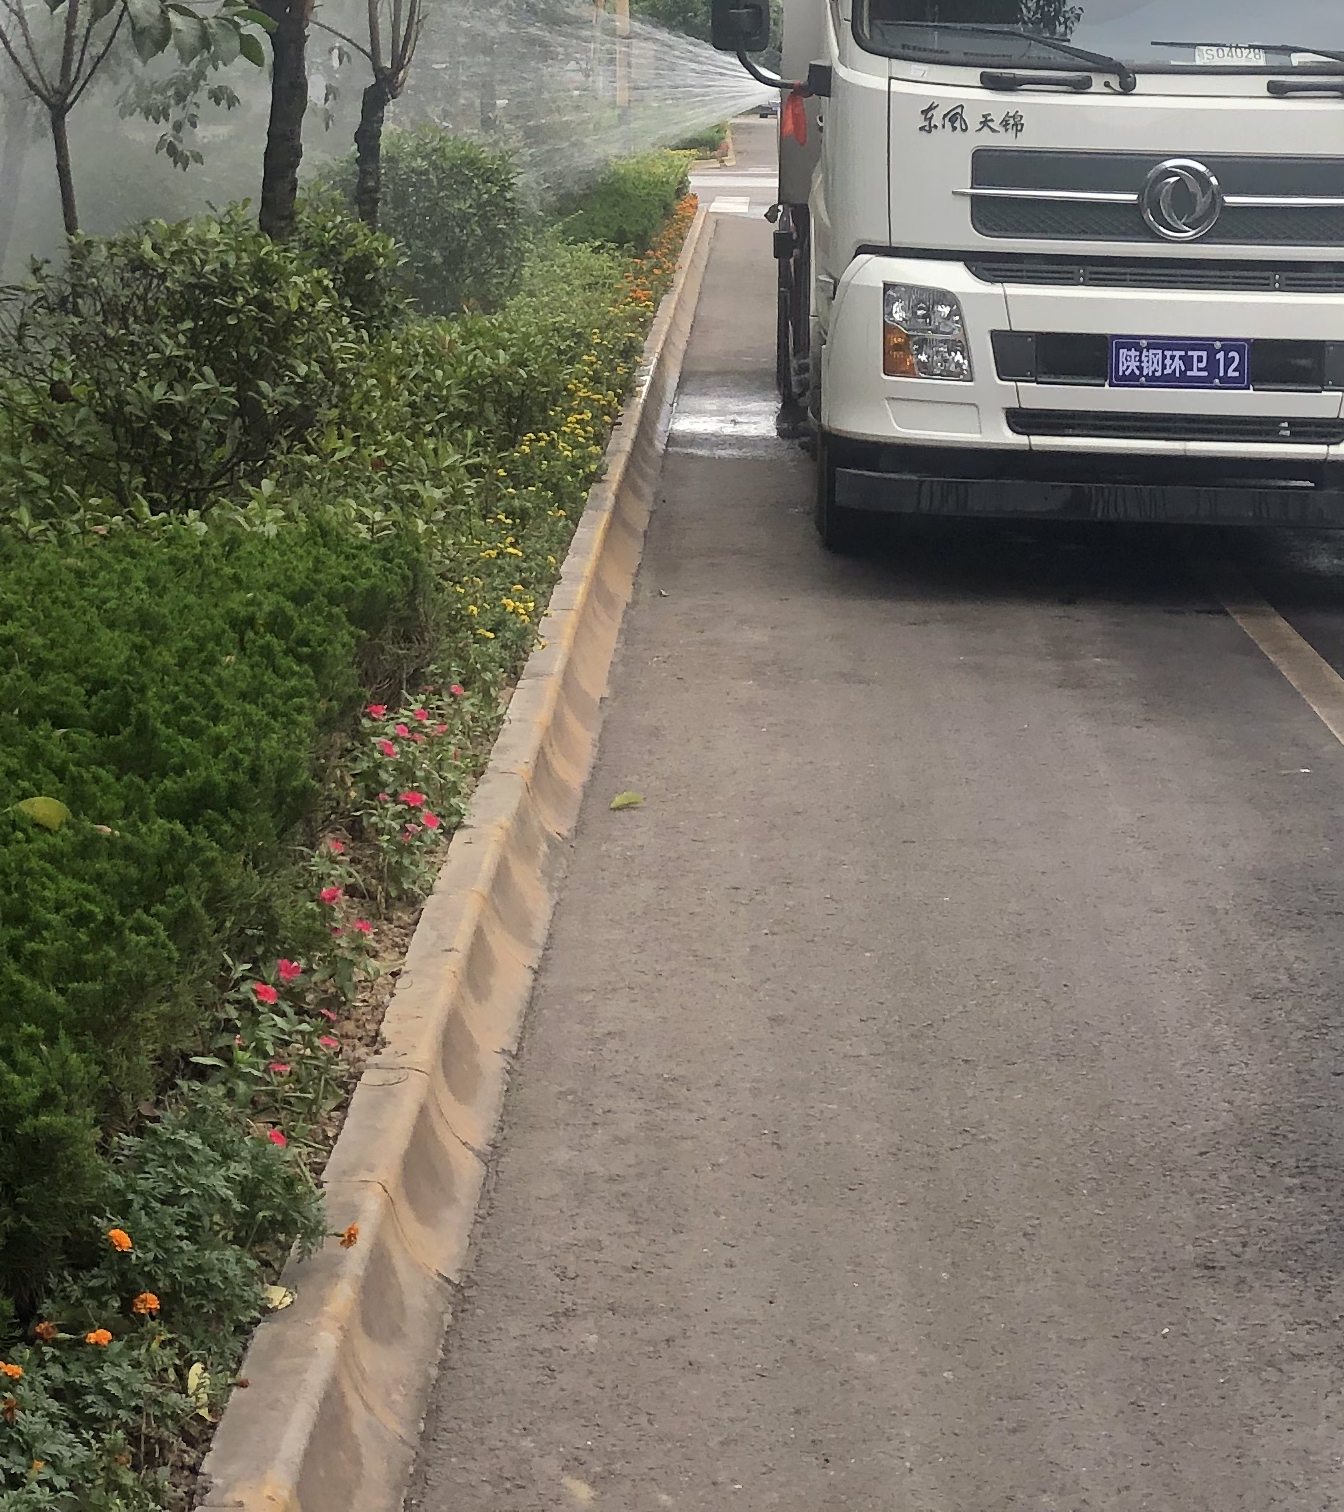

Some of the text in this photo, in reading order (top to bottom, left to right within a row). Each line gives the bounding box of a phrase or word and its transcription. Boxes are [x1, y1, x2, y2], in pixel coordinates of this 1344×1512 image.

[1118, 348, 1240, 377] 陕钢环卫 12
